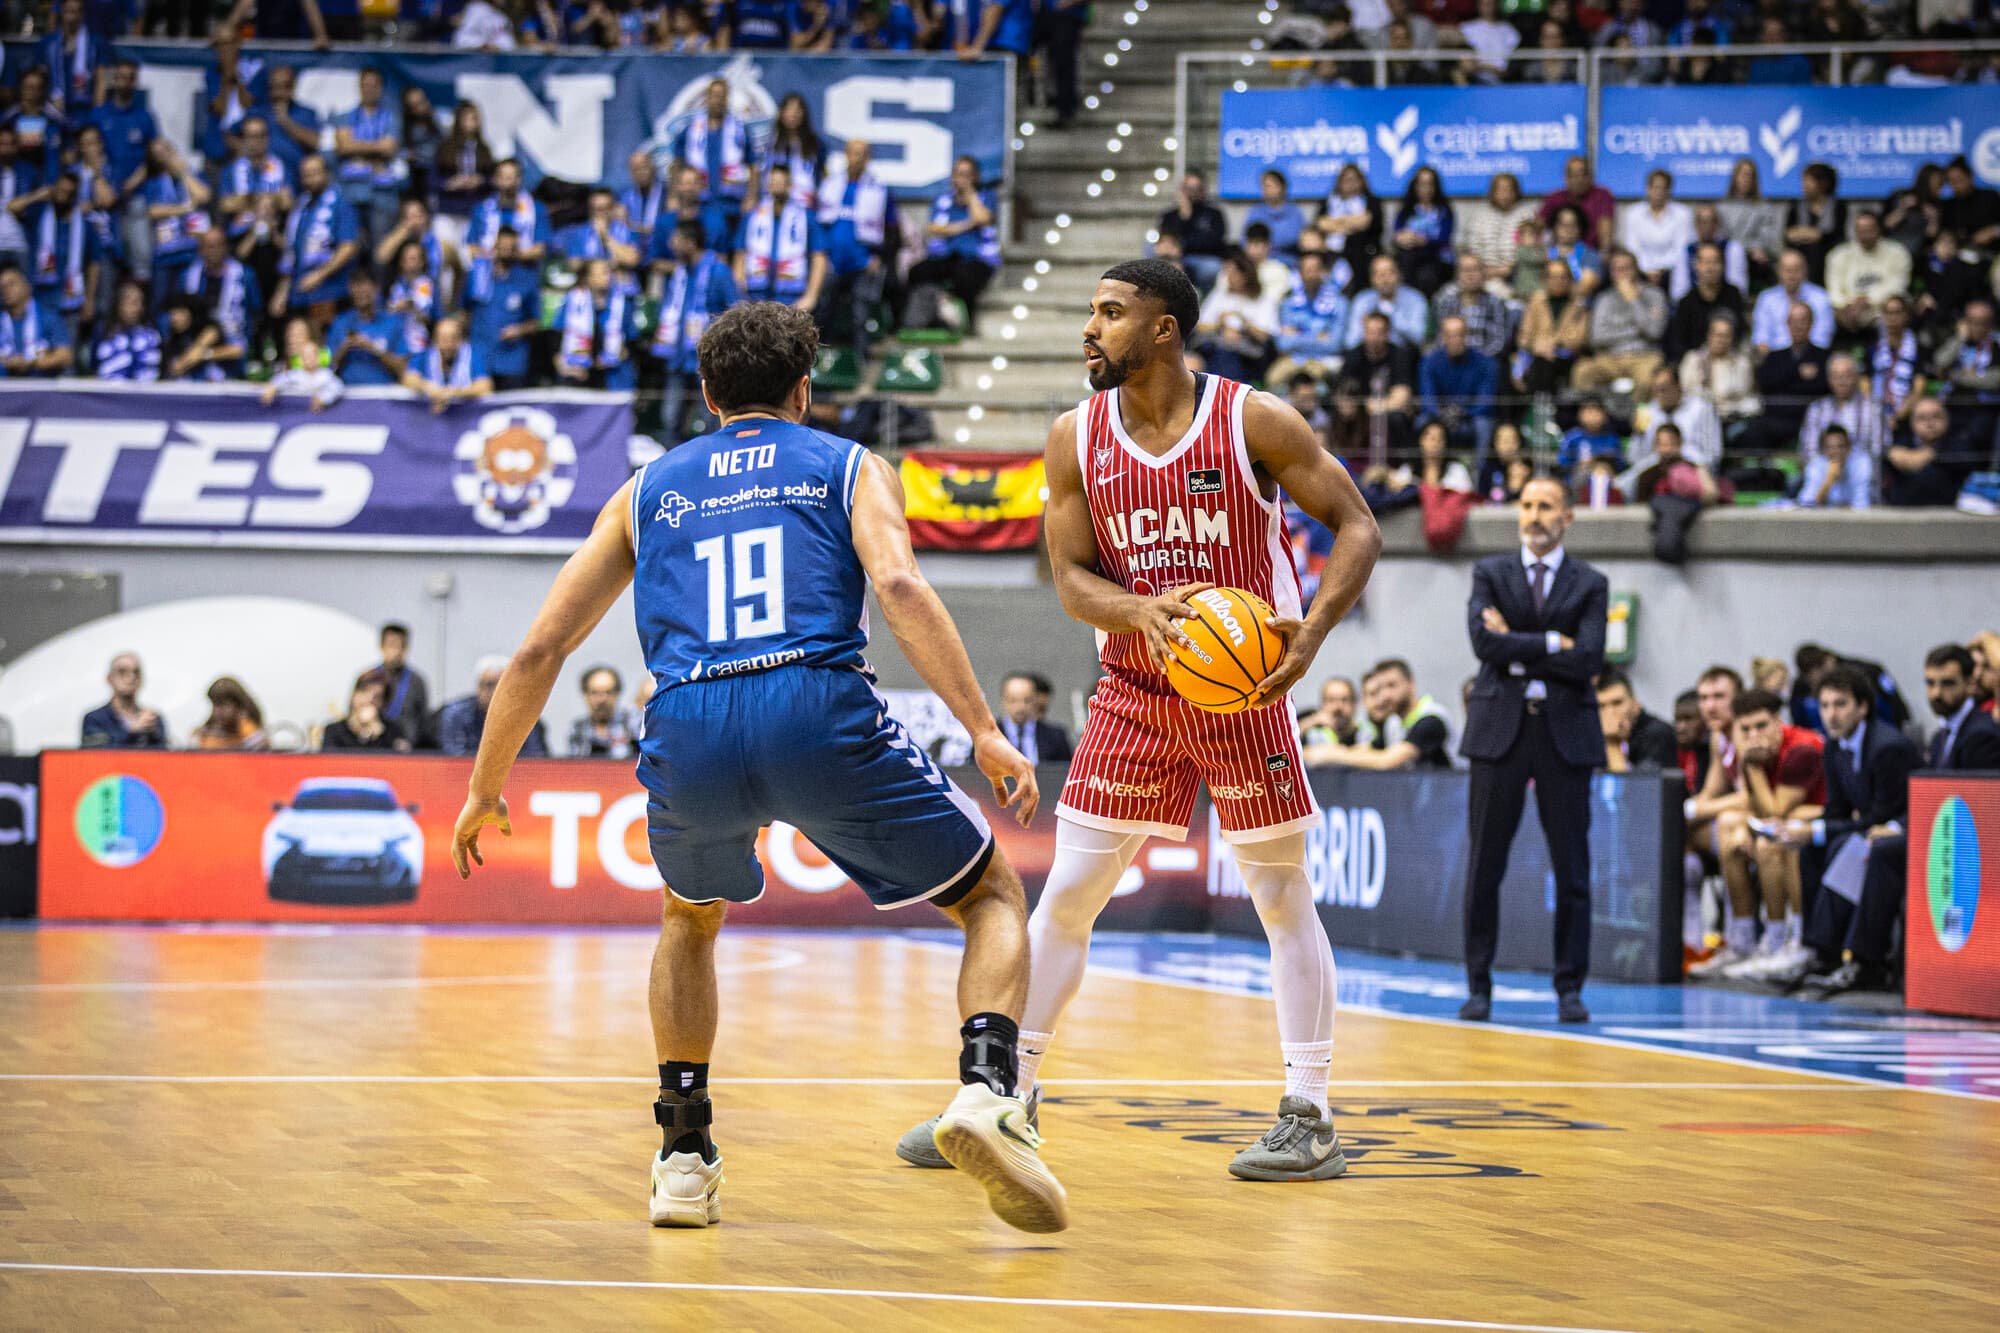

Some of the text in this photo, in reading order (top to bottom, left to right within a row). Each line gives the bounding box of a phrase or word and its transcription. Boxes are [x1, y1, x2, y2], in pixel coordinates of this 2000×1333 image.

[1223, 113, 1580, 164] cajaviva cajarural
[1604, 118, 1963, 161] cajaviva cajarural
[708, 443, 777, 478] NETO
[701, 481, 828, 510] recoletas salud
[1191, 483, 1221, 492] endesa
[1107, 505, 1231, 550] UCAM
[1127, 548, 1213, 574] MURCIA
[693, 525, 787, 643] 19
[1194, 588, 1248, 648] Wilson
[1269, 760, 1286, 770] acb
[1088, 774, 1161, 799] INVERSUS
[1304, 805, 1387, 909] BRID
